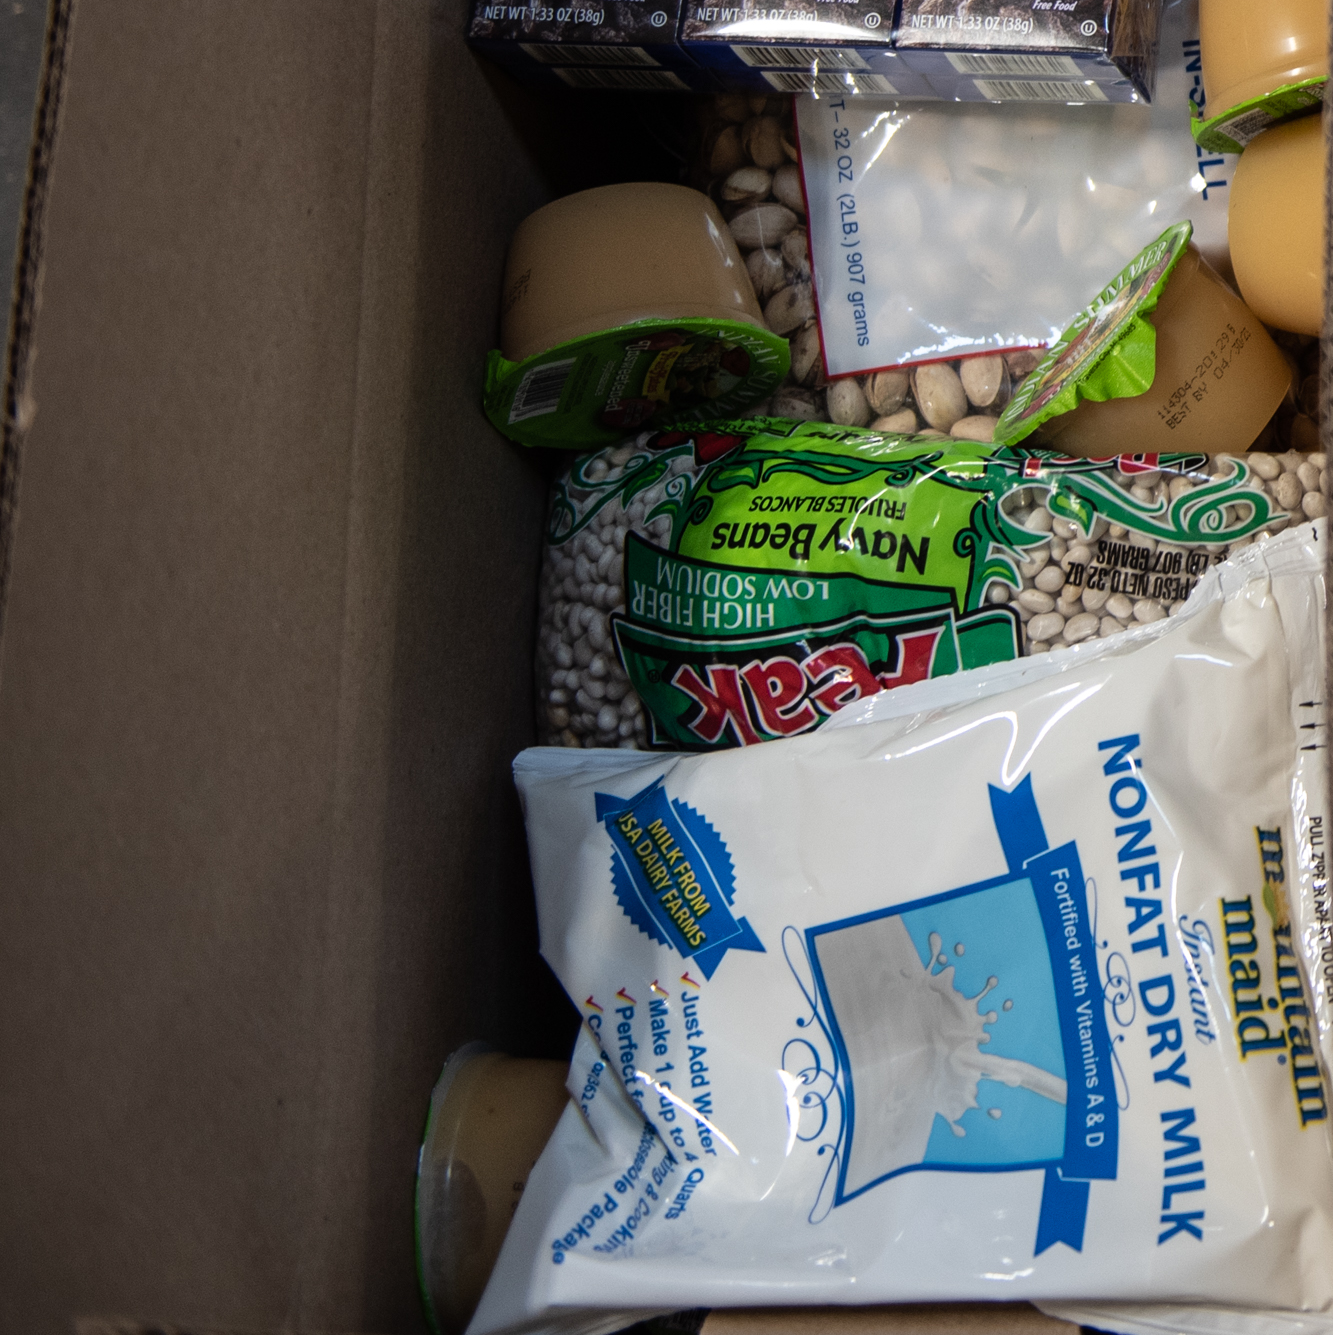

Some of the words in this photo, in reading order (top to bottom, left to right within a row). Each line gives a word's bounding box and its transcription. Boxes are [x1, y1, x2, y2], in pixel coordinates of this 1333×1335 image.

[484, 6, 509, 20] NET
[508, 6, 528, 20] WT
[530, 7, 555, 22] 1.33
[555, 8, 572, 22] OZ
[573, 8, 606, 26] (38g)
[911, 14, 934, 29] NET
[935, 14, 956, 29] WT
[958, 16, 982, 31] 1.33
[1002, 17, 1035, 35] (38g)
[1053, 0, 1078, 12] Food
[832, 127, 851, 152] 32
[836, 155, 855, 184] OZ
[836, 193, 861, 248] (2LB.)
[846, 250, 867, 286] 907
[848, 288, 871, 348] grams
[749, 494, 823, 515] BLANCOS
[825, 494, 908, 519] FRIJOLES
[711, 523, 813, 560] Beans
[818, 526, 931, 576] Navy
[1096, 540, 1151, 571] GRAMS
[657, 559, 757, 602] SODIUM
[1086, 566, 1109, 592] 32
[1151, 550, 1183, 575] 907
[762, 576, 830, 603] LOW
[1110, 569, 1150, 596] NETO
[630, 583, 699, 627] FIBER
[702, 597, 777, 627] HIGH
[1096, 732, 1170, 955] NONFAT
[1309, 815, 1325, 850] PULL
[647, 817, 684, 864] MILK
[672, 862, 712, 916] FROM
[637, 840, 673, 892] DAIRY
[661, 888, 707, 947] FARMS
[1049, 867, 1083, 951] Fortified
[1068, 955, 1089, 998] with
[1217, 895, 1287, 1064] maid
[648, 998, 671, 1057] Make
[680, 990, 702, 1041] Just
[1140, 968, 1194, 1089] DRY
[614, 1005, 639, 1083] Perfect
[1075, 999, 1100, 1090] Vitamins
[688, 1044, 710, 1089] Add
[1086, 1092, 1105, 1111] A
[669, 1126, 687, 1149] to
[1086, 1112, 1105, 1129] &
[1085, 1130, 1105, 1149] D
[663, 1167, 705, 1221] Quarts
[1156, 1109, 1208, 1247] MILK
